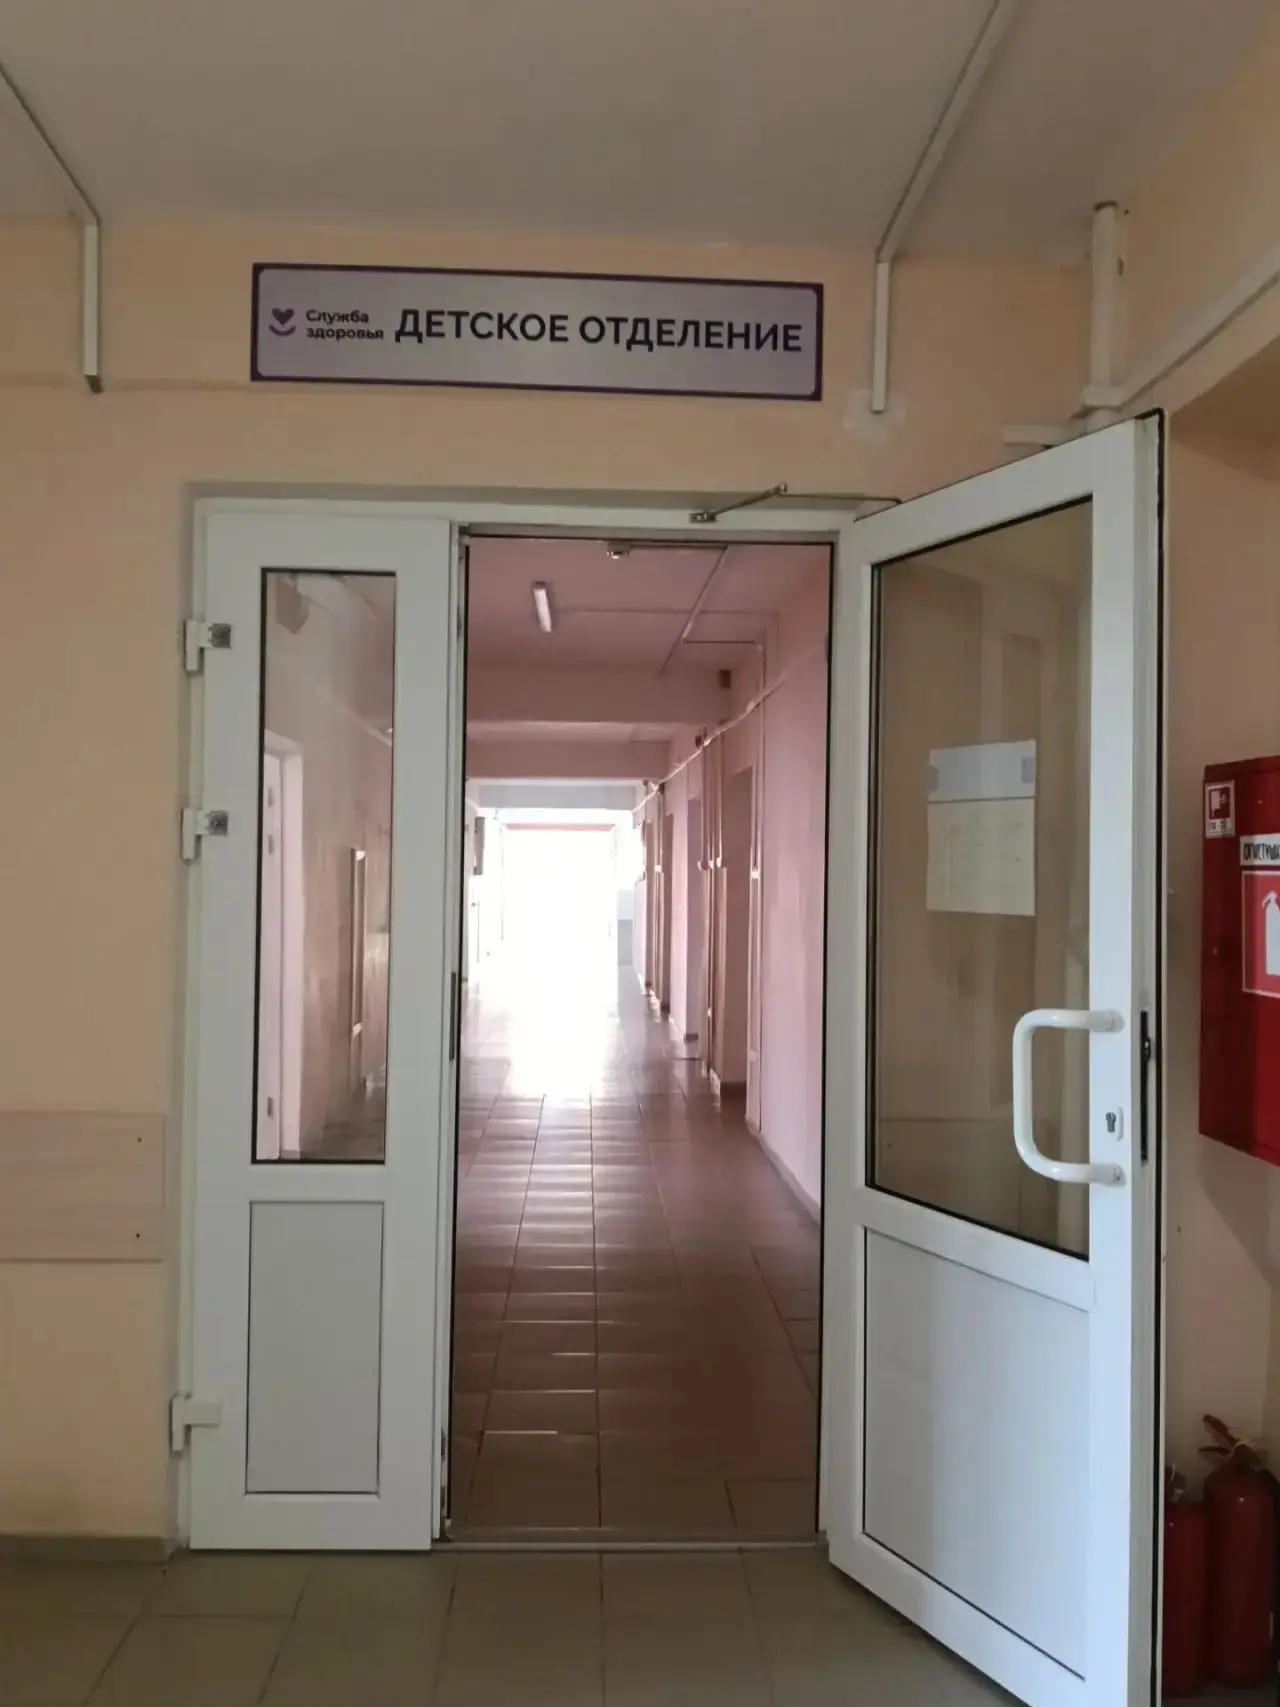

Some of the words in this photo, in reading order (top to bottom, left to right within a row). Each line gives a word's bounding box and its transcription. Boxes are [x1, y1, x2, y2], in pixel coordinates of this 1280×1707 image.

[305, 309, 370, 325] Служба
[305, 327, 385, 342] здоровья
[394, 308, 570, 345] ДЕТСКОЕ
[578, 315, 803, 354] ОТДЕЛЕНИЕ
